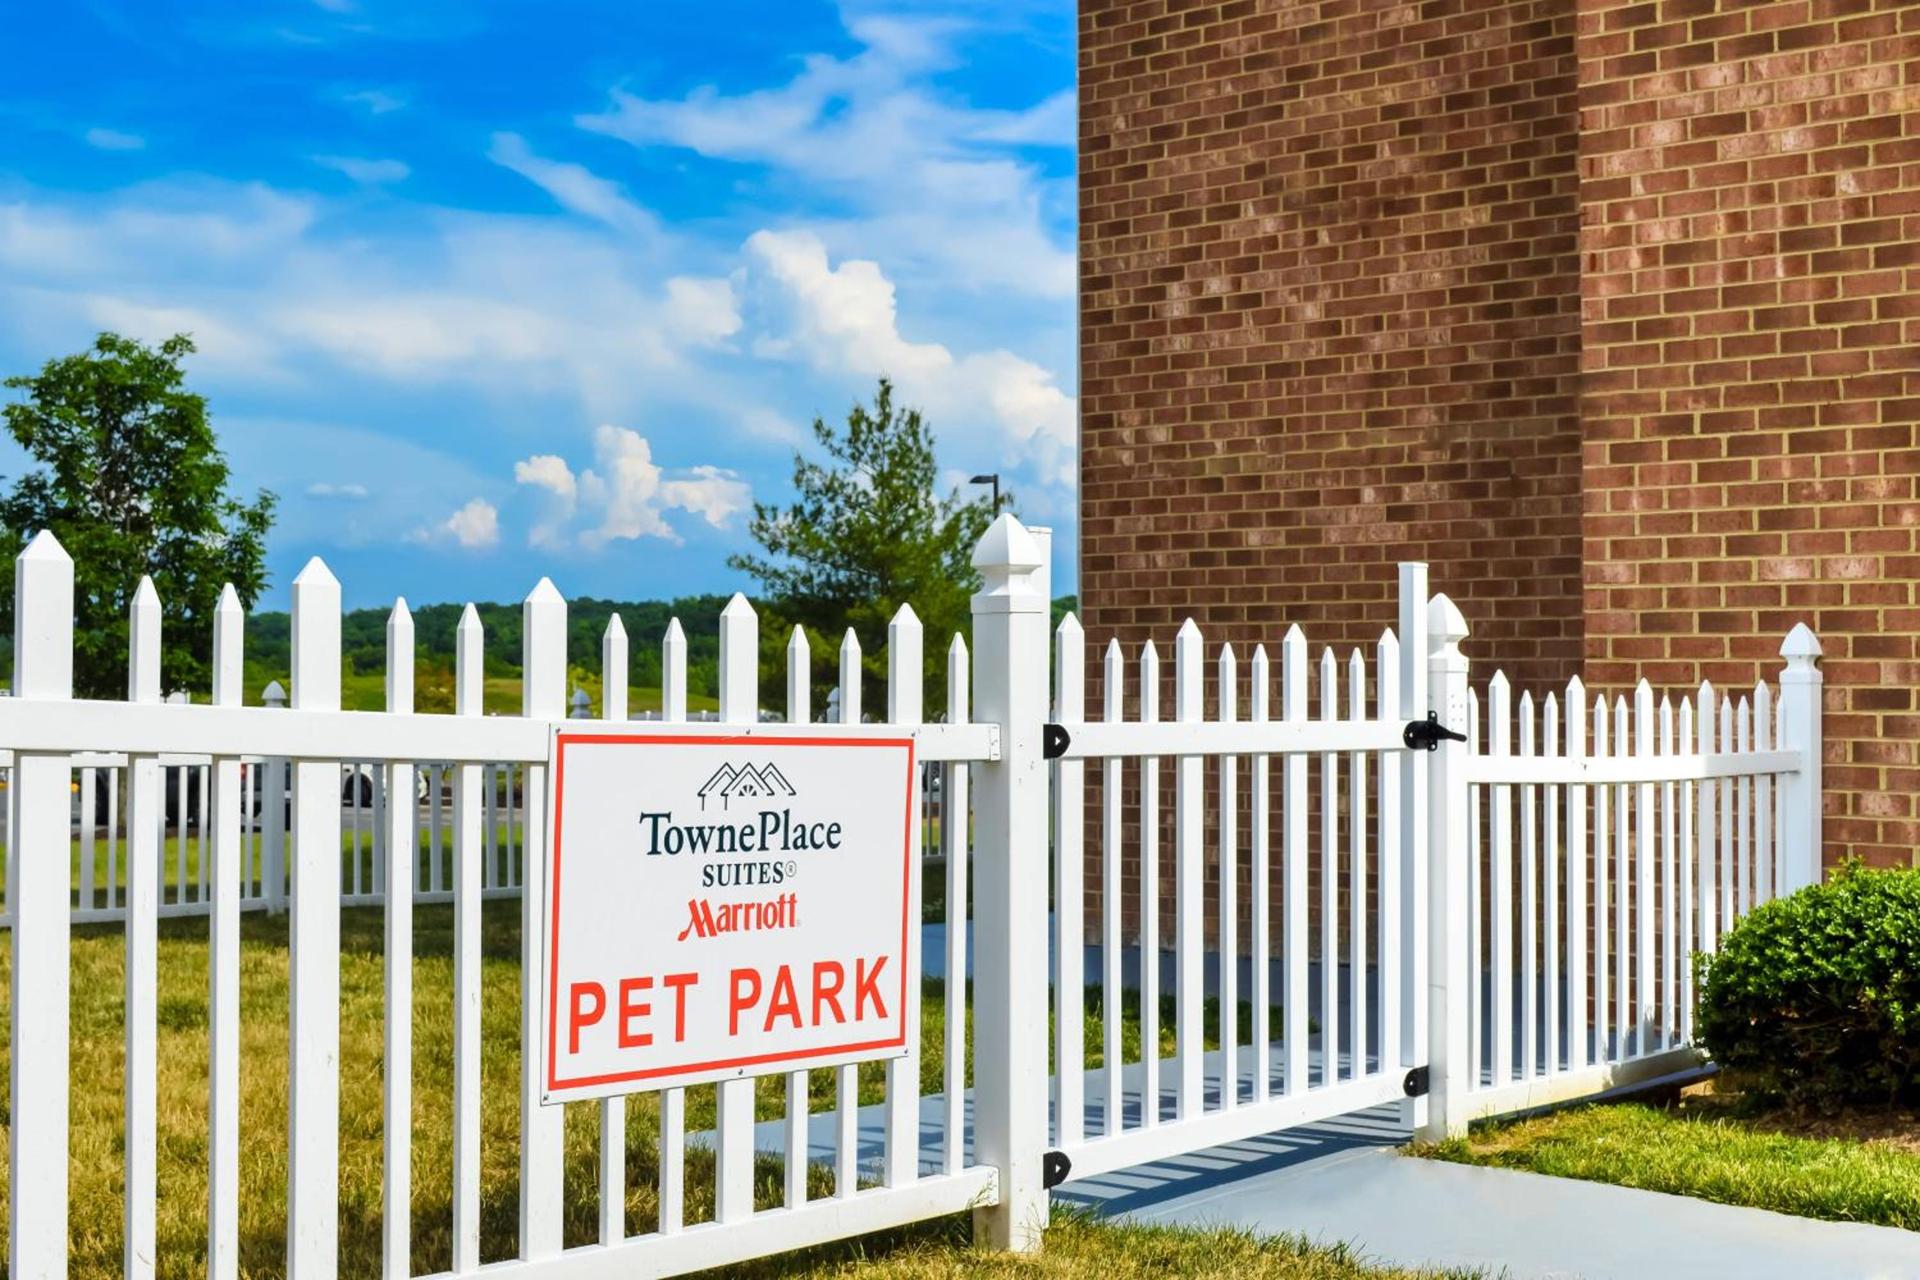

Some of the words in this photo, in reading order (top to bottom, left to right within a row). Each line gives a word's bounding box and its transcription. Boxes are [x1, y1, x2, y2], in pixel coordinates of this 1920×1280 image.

[639, 808, 842, 855] TownePlace
[677, 893, 798, 941] Marriott
[569, 972, 698, 1054] PET
[729, 956, 888, 1036] PARK
